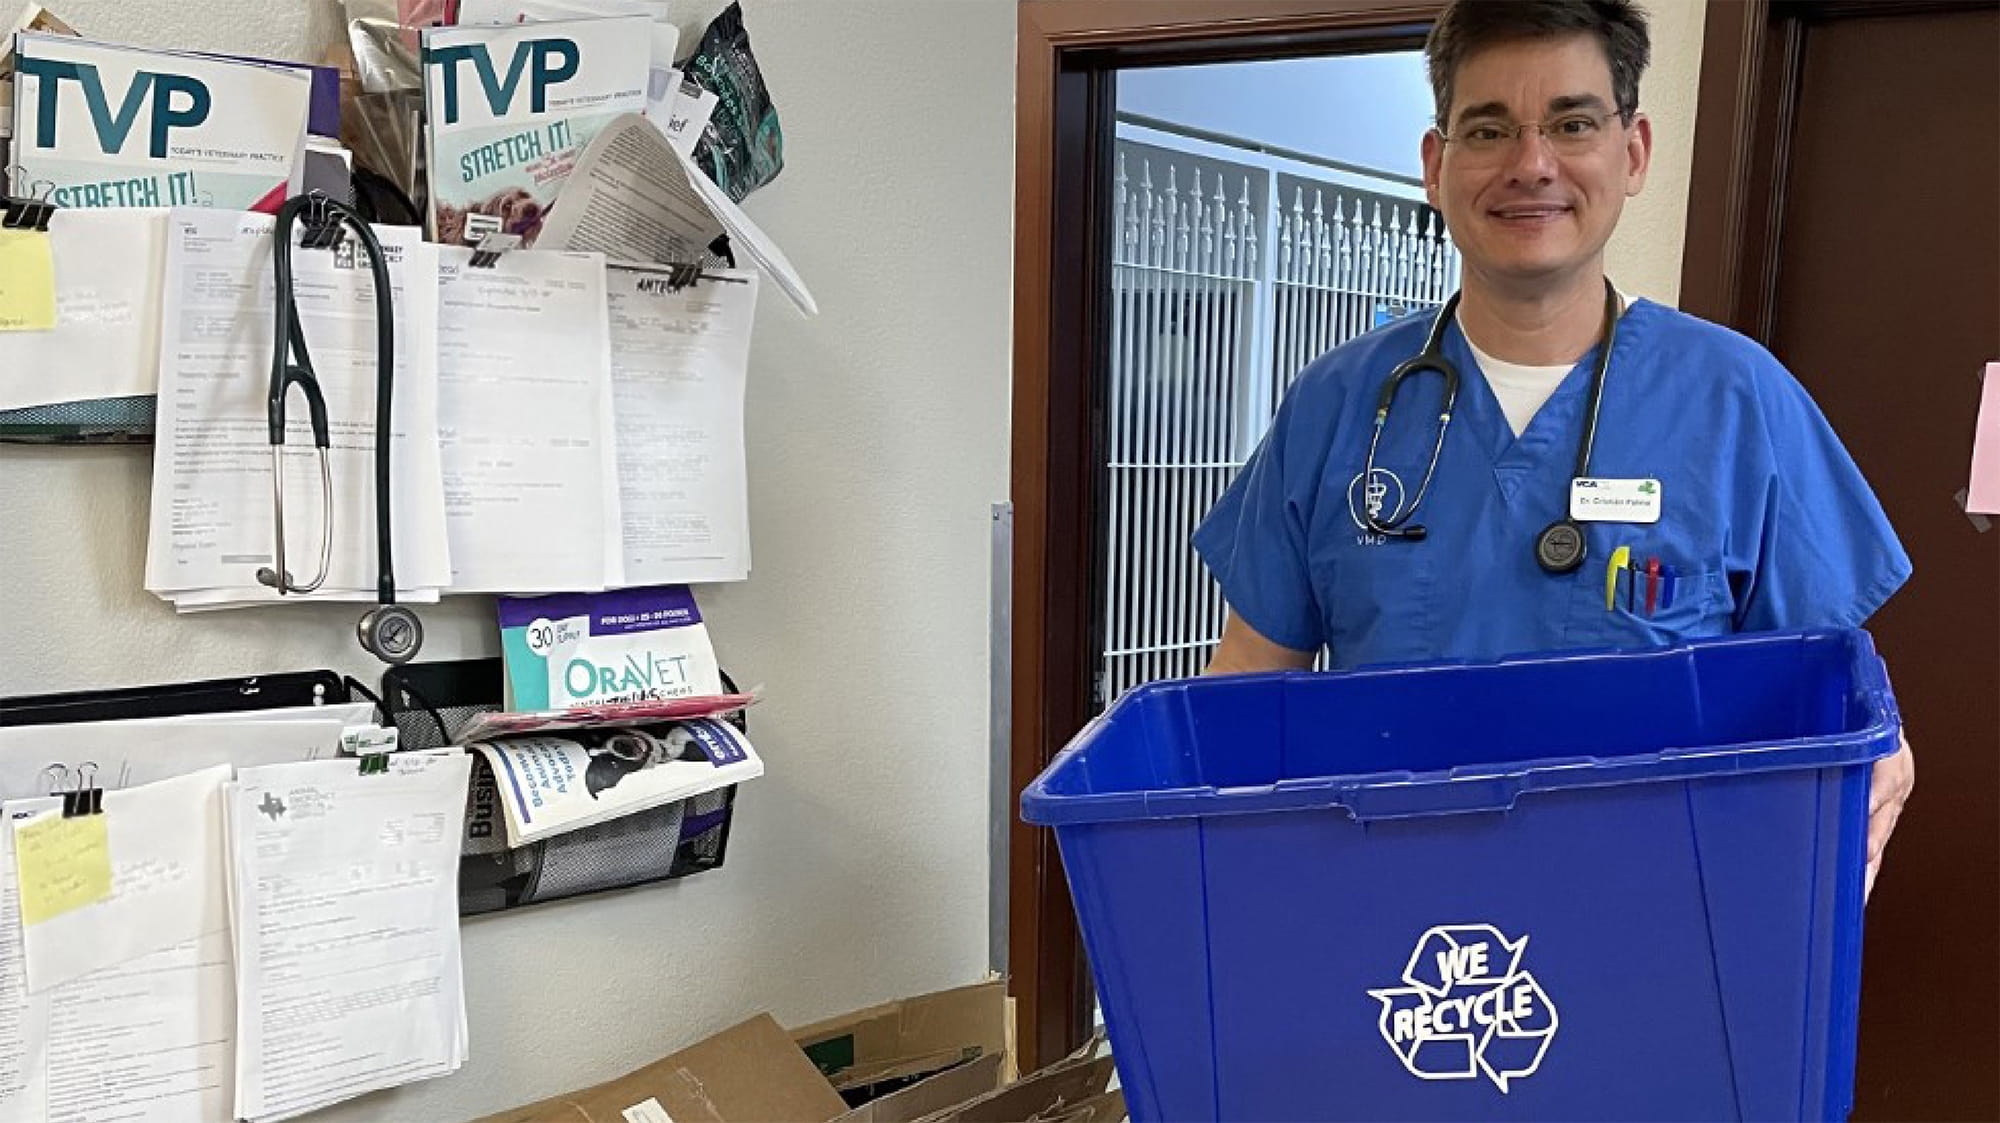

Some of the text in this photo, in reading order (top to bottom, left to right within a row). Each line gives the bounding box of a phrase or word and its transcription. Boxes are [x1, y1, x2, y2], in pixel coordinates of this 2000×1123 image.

[16, 57, 212, 159] TVP
[427, 38, 581, 124] TVP
[460, 130, 542, 183] STRETCH
[547, 118, 572, 152] IT!
[54, 169, 198, 207] STRETCH IT!
[1357, 534, 1387, 546] VMD
[529, 626, 554, 649] 30
[515, 752, 544, 808] Become
[1436, 941, 1490, 982] WE
[1393, 983, 1534, 1044] RECYCLE
